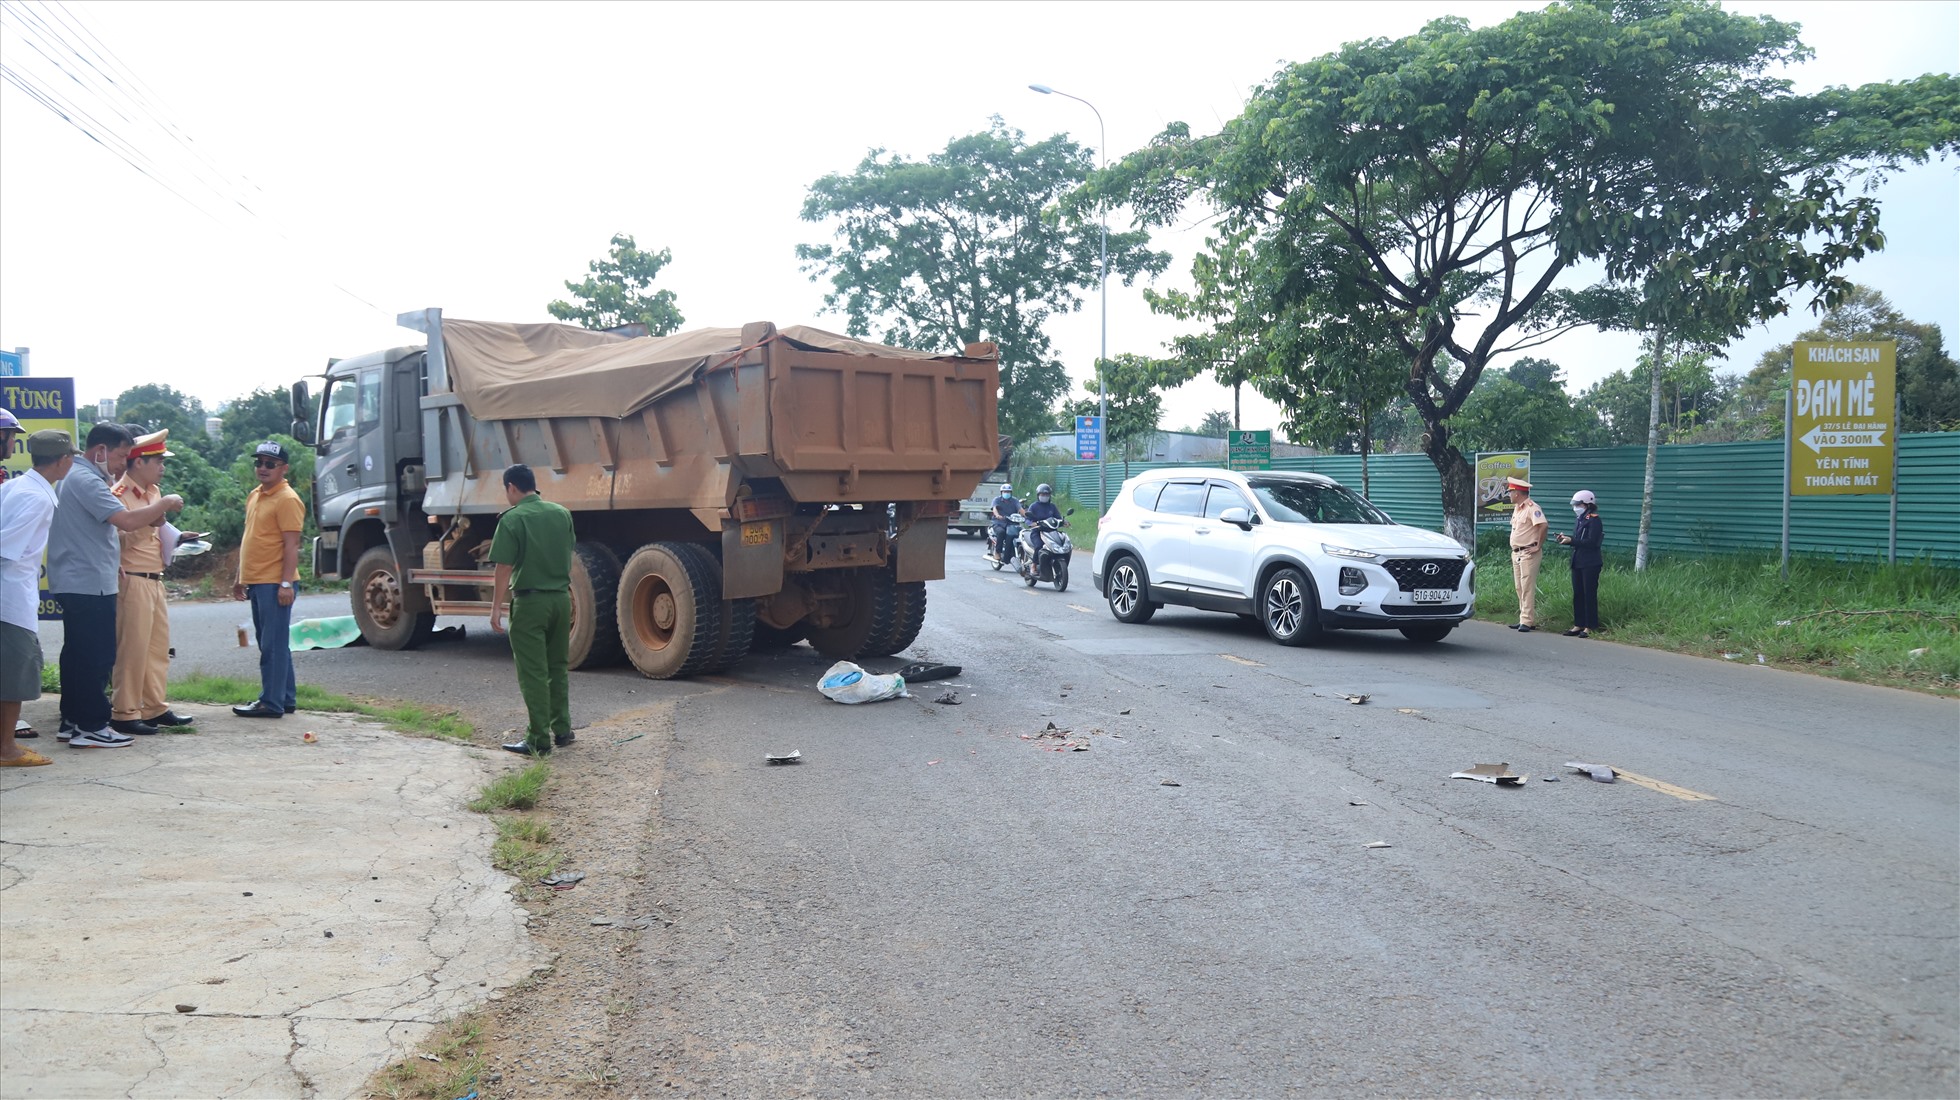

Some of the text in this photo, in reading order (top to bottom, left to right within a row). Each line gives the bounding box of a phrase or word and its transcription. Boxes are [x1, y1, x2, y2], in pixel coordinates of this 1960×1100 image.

[1808, 344, 1880, 366] KHÁCH SẠN
[3, 386, 63, 415] TÙNG
[1796, 371, 1875, 419] ĐAM MÊ
[1842, 420, 1852, 430] LÊ
[1813, 433, 1873, 445] VÀO 300M
[1480, 462, 1512, 470] Coffee
[1816, 456, 1870, 469] YÊN TĨNH
[1804, 472, 1879, 487] THOÁNG MÁT
